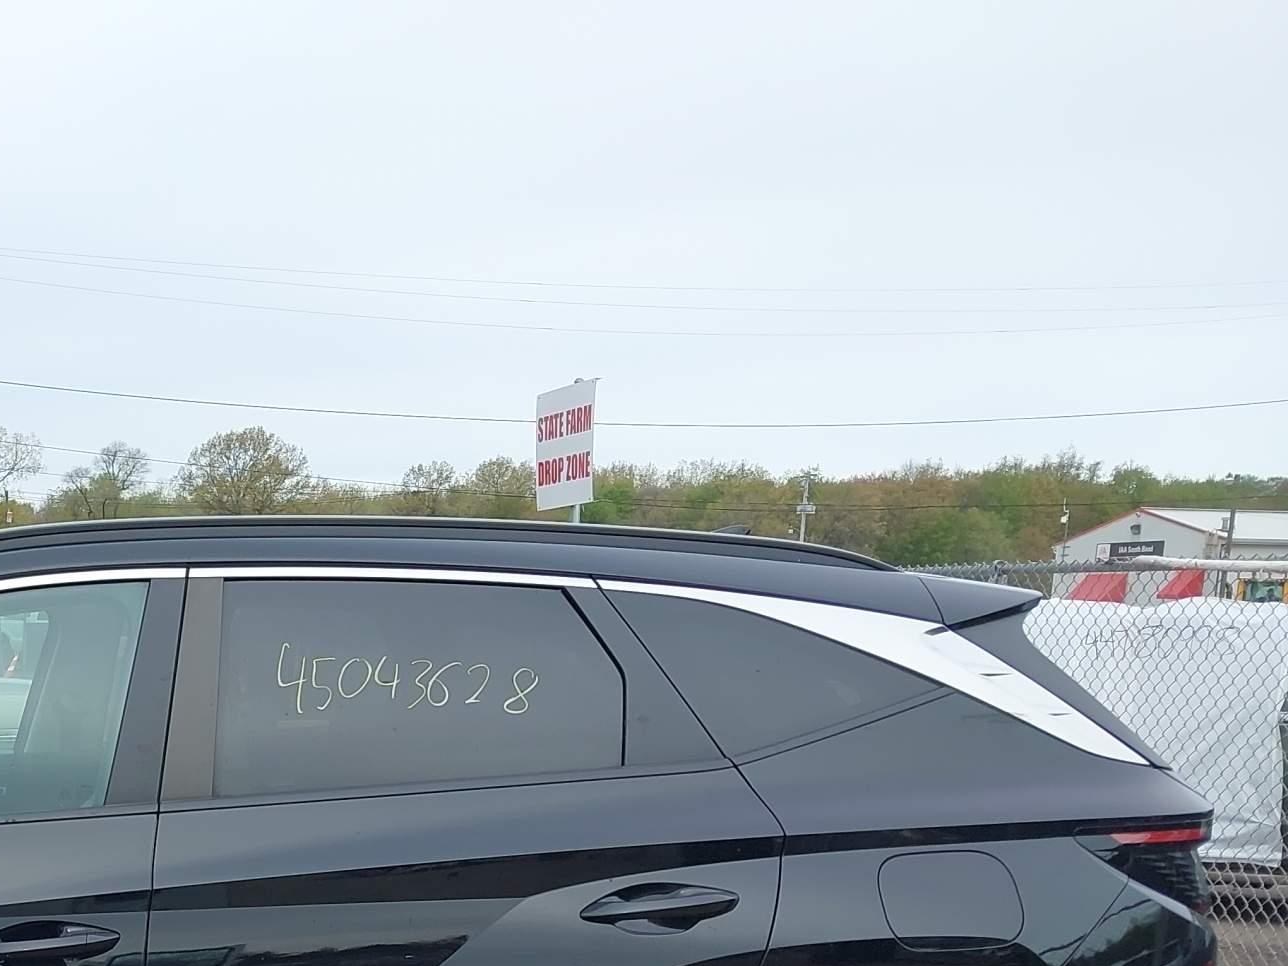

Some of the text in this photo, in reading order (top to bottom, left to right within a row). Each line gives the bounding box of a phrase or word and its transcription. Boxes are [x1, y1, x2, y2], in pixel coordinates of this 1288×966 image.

[537, 404, 592, 443] STATE FARM
[537, 451, 591, 487] DROP ZONE
[277, 642, 539, 714] 45043628
